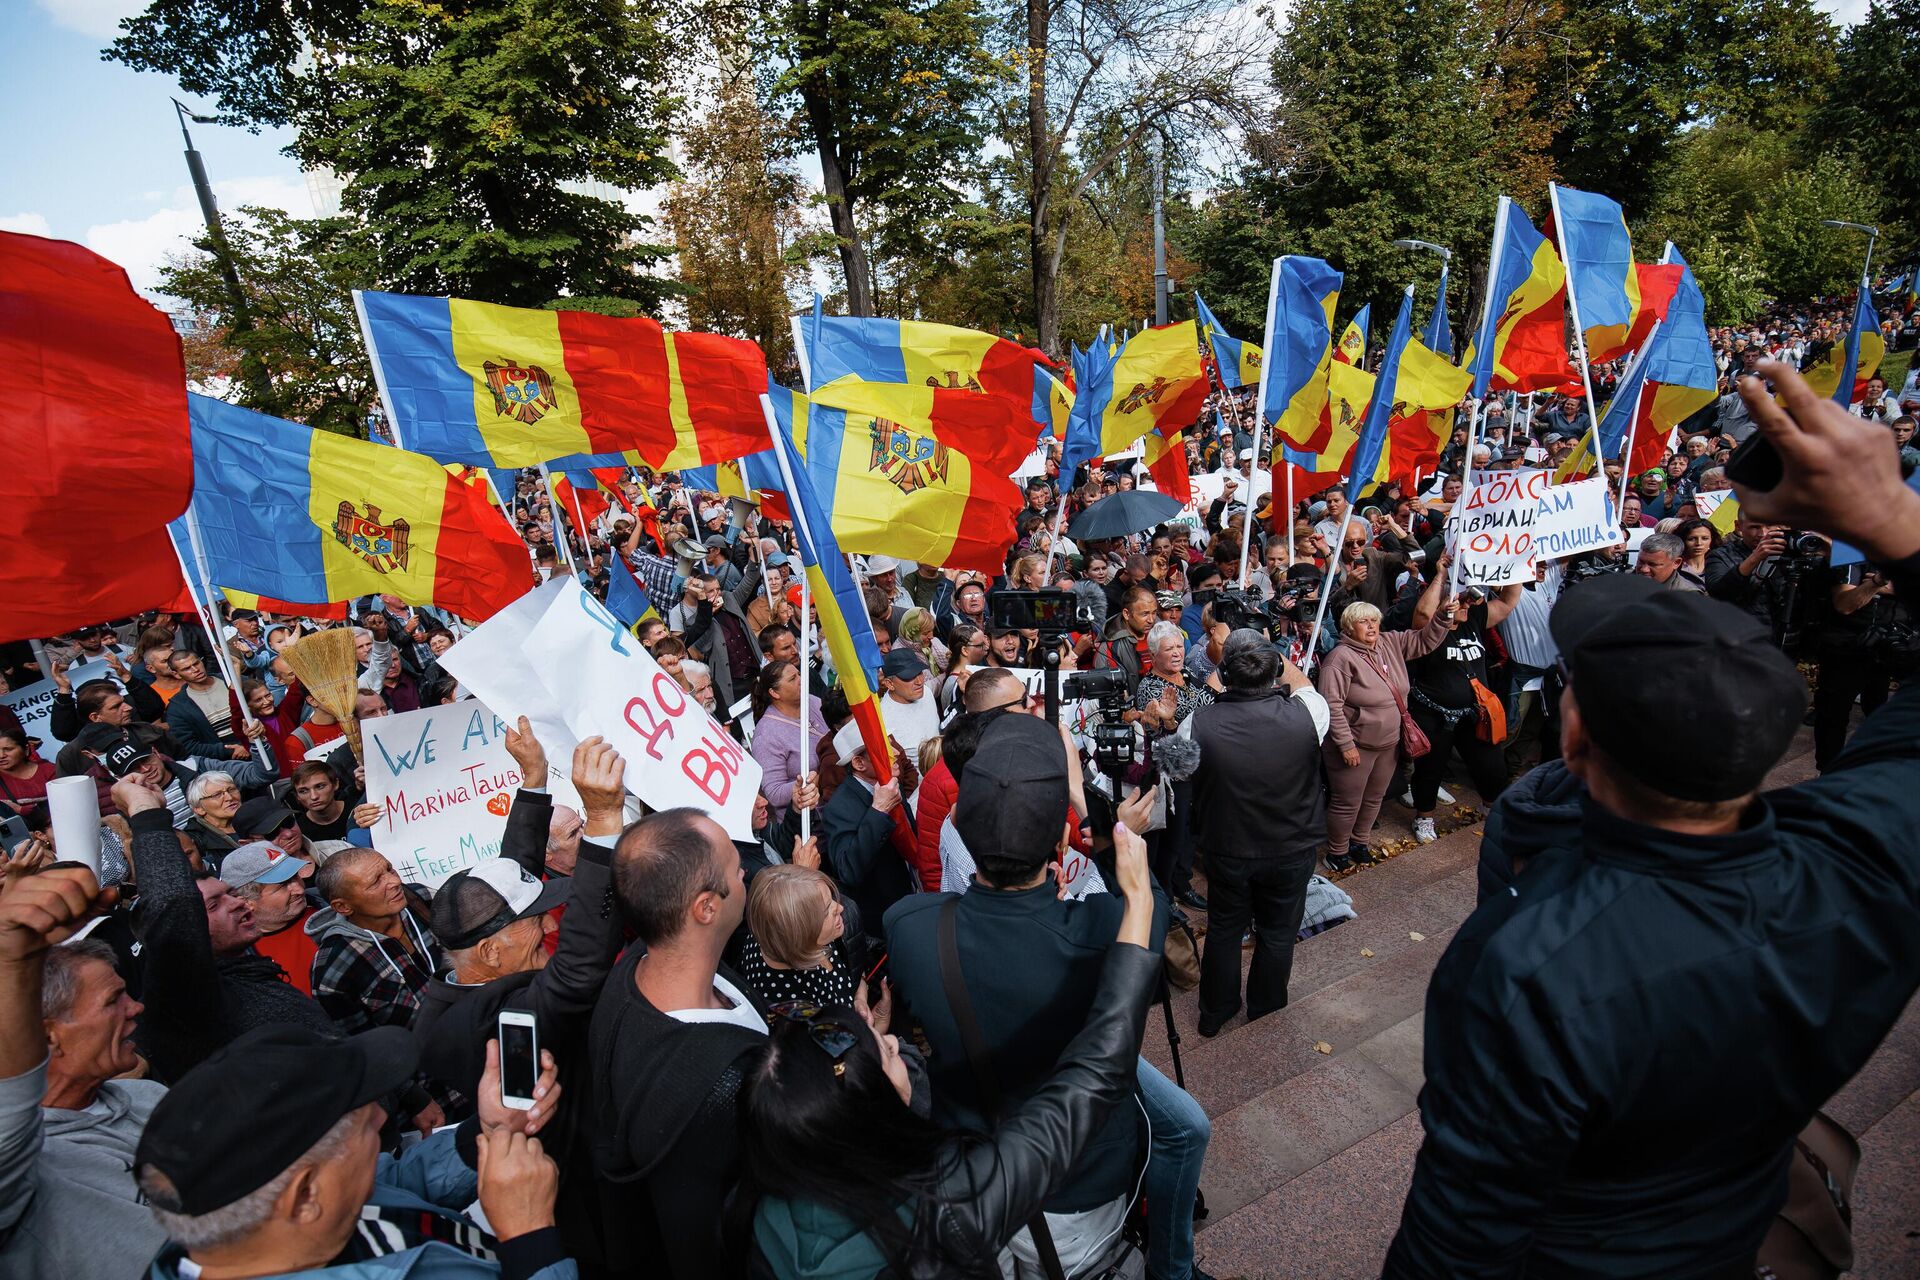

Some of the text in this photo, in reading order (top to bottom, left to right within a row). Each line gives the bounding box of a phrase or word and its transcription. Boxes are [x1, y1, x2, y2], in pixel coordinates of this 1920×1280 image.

[1536, 490, 1574, 517] АМ
[1446, 508, 1535, 536] ГАВРИЛИ
[1454, 533, 1534, 555] ОЛО
[624, 672, 687, 762] ДО
[112, 745, 136, 764] FBI
[373, 708, 507, 777] WE AR
[681, 720, 744, 806] ВЫ
